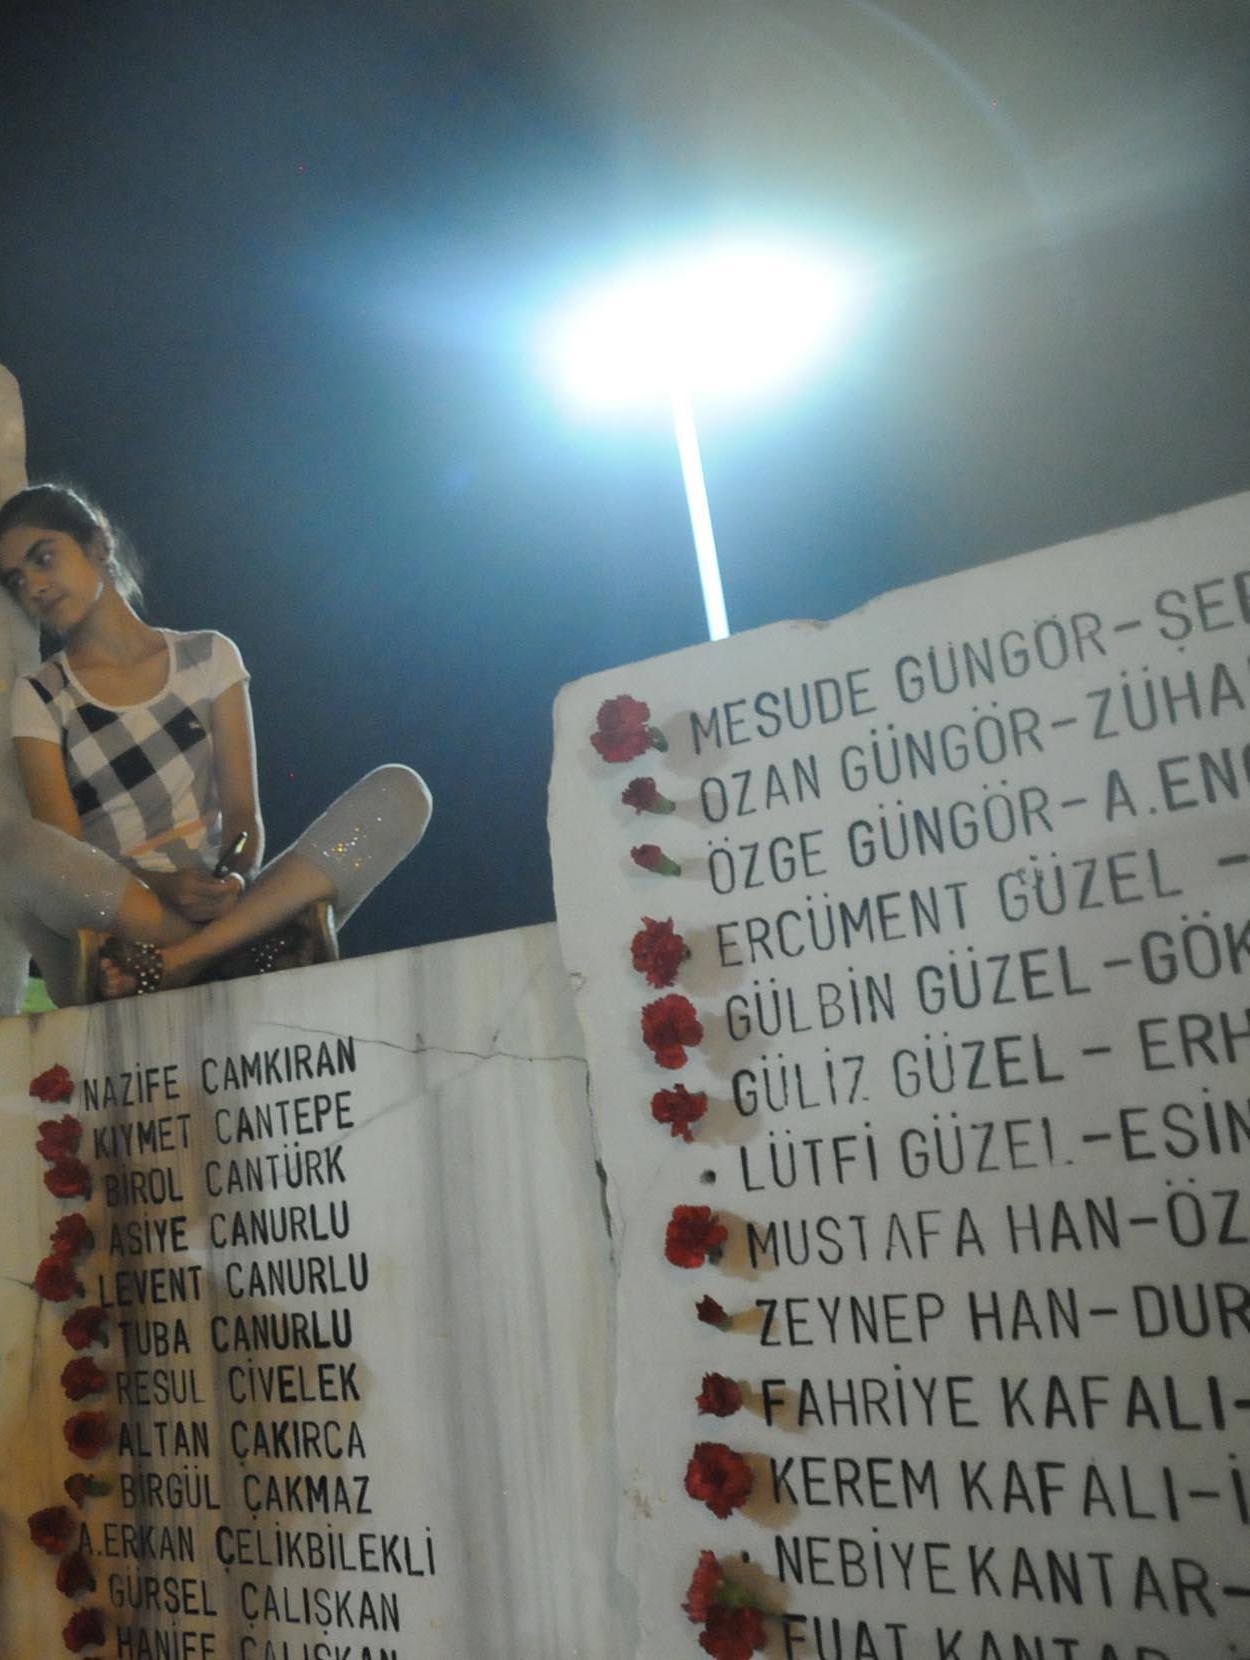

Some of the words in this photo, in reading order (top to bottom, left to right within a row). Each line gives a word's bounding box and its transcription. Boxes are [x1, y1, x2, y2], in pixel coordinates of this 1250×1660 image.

[689, 667, 878, 755] MESUDE
[895, 611, 1107, 703] GÜNGÖR
[699, 753, 823, 823] OZAN
[841, 700, 1044, 792] GÜNGÖR
[1086, 654, 1250, 740] ZÜHA
[707, 829, 828, 895] ÖZGE
[848, 780, 1054, 868] GÜNGÖR
[1105, 744, 1250, 822] A.EN
[716, 882, 968, 968] ERCÜMENT
[997, 848, 1184, 923] GÜZEL
[724, 966, 896, 1042] GÜLBİN
[916, 944, 1092, 1015] GÜZEL
[83, 1062, 181, 1112] NAZİFE
[201, 1036, 357, 1096] CAMKIRAN
[732, 1046, 870, 1117] GÜLİZ
[892, 1031, 1066, 1099] GÜZEL
[94, 1114, 191, 1160] KIYMET
[214, 1091, 355, 1145] CANTEPE
[739, 1121, 879, 1192] LÜTFİ
[900, 1111, 1075, 1179] GÜZEL
[105, 1164, 184, 1208] BİROL
[205, 1141, 347, 1198] CANTÜRK
[109, 1211, 189, 1257] ASİYE
[210, 1201, 351, 1250] CANURLU
[745, 1206, 986, 1270] MUSTAFA
[1007, 1196, 1121, 1254] HAN
[98, 1265, 203, 1309] LEVENT
[226, 1252, 369, 1300] CANURLU
[118, 1319, 192, 1358] TUBA
[210, 1308, 352, 1354] CANURLU
[755, 1292, 946, 1347] ZEYNEP
[968, 1287, 1081, 1341] HAN
[116, 1370, 206, 1406] RESUL
[228, 1358, 361, 1405] CİVELEK
[760, 1364, 981, 1428] FAHRİYE
[118, 1421, 211, 1459] ALTAN
[231, 1420, 367, 1468] ÇAKIRCA
[243, 1474, 373, 1520] ÇAKMAZ
[768, 1456, 940, 1510] KEREM
[216, 1522, 437, 1577] ÇELİKBİLEKLİ
[775, 1527, 956, 1595] NEBİYE
[108, 1567, 219, 1618] GÜRSEL
[241, 1582, 401, 1637] ÇALIŞKAN
